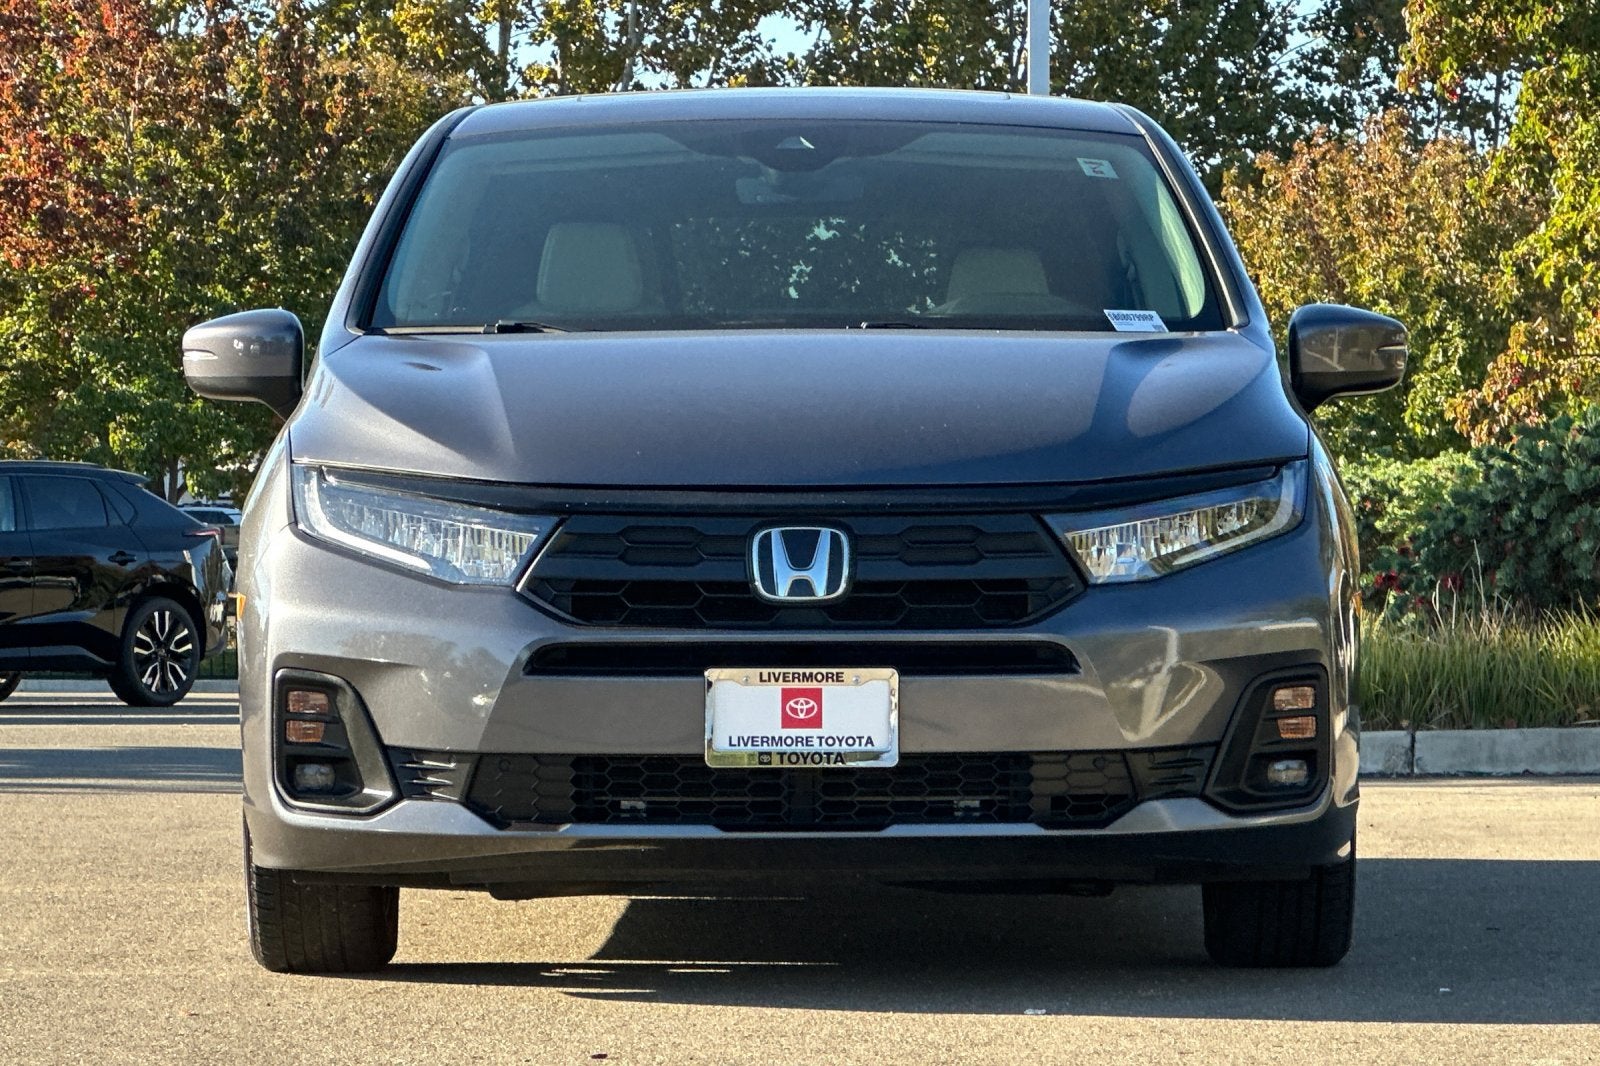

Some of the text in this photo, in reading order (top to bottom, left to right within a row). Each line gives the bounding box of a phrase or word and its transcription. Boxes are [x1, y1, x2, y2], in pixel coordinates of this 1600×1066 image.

[759, 672, 845, 683] LIVERMORE
[728, 736, 875, 747] LIVERMORE TOYOTA
[778, 752, 846, 765] TOYOTA
